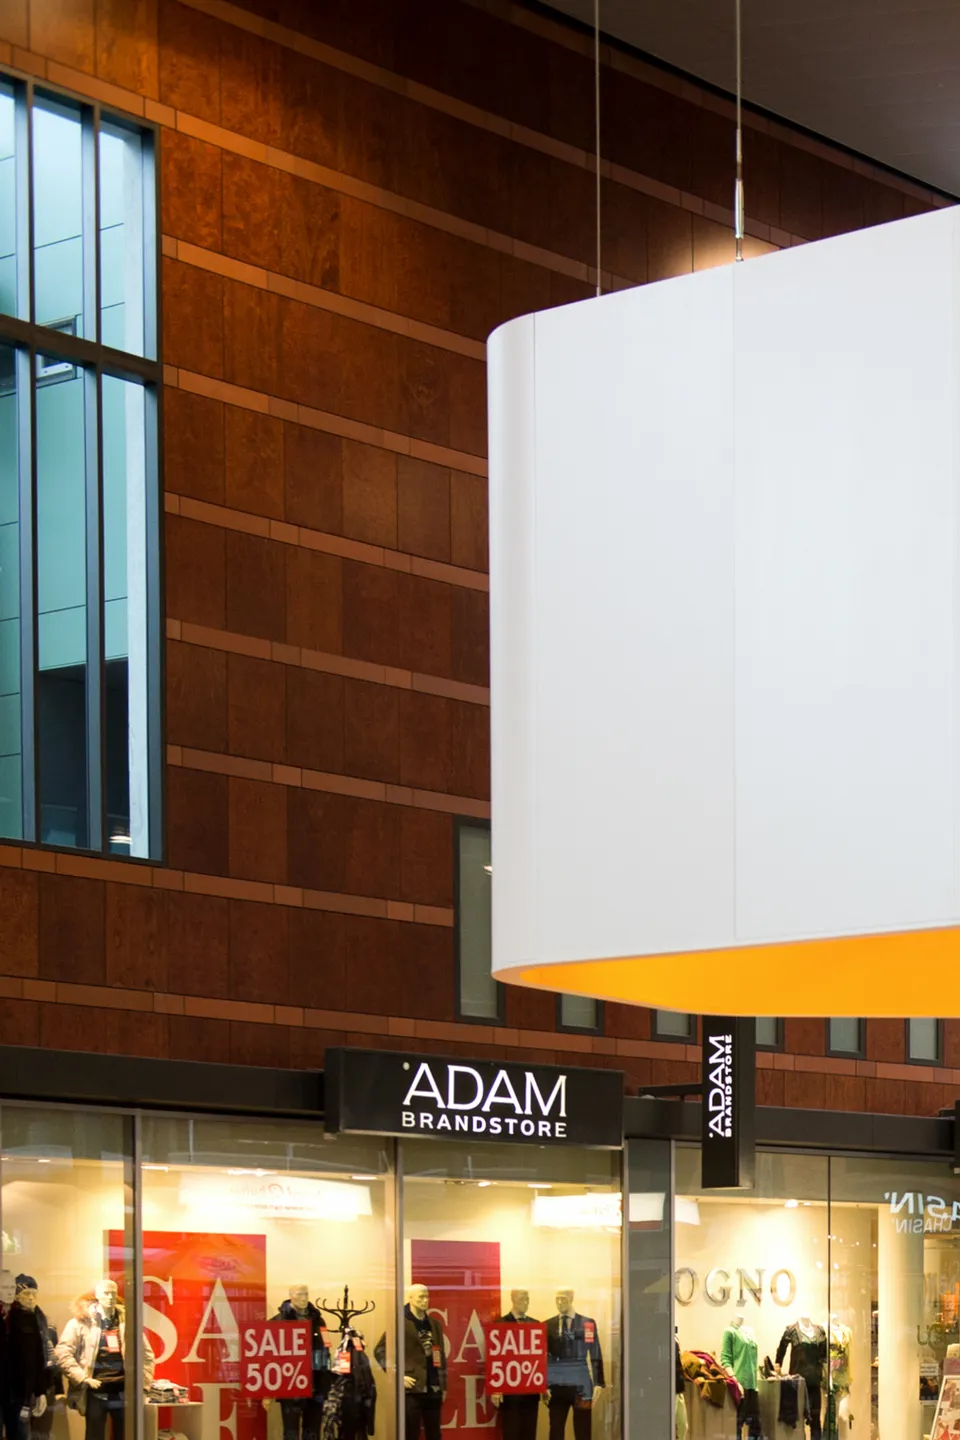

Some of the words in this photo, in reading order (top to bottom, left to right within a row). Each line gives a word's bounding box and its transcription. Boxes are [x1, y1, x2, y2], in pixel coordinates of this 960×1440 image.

[403, 1062, 567, 1117] ADAM
[708, 1035, 725, 1138] ADAM
[724, 1034, 732, 1138] BRANDSTORE
[402, 1111, 567, 1138] BRANDSTORE
[244, 1328, 307, 1357] SALE
[489, 1329, 543, 1356] SALE
[245, 1361, 309, 1392] 50%
[489, 1360, 544, 1388] 50%
